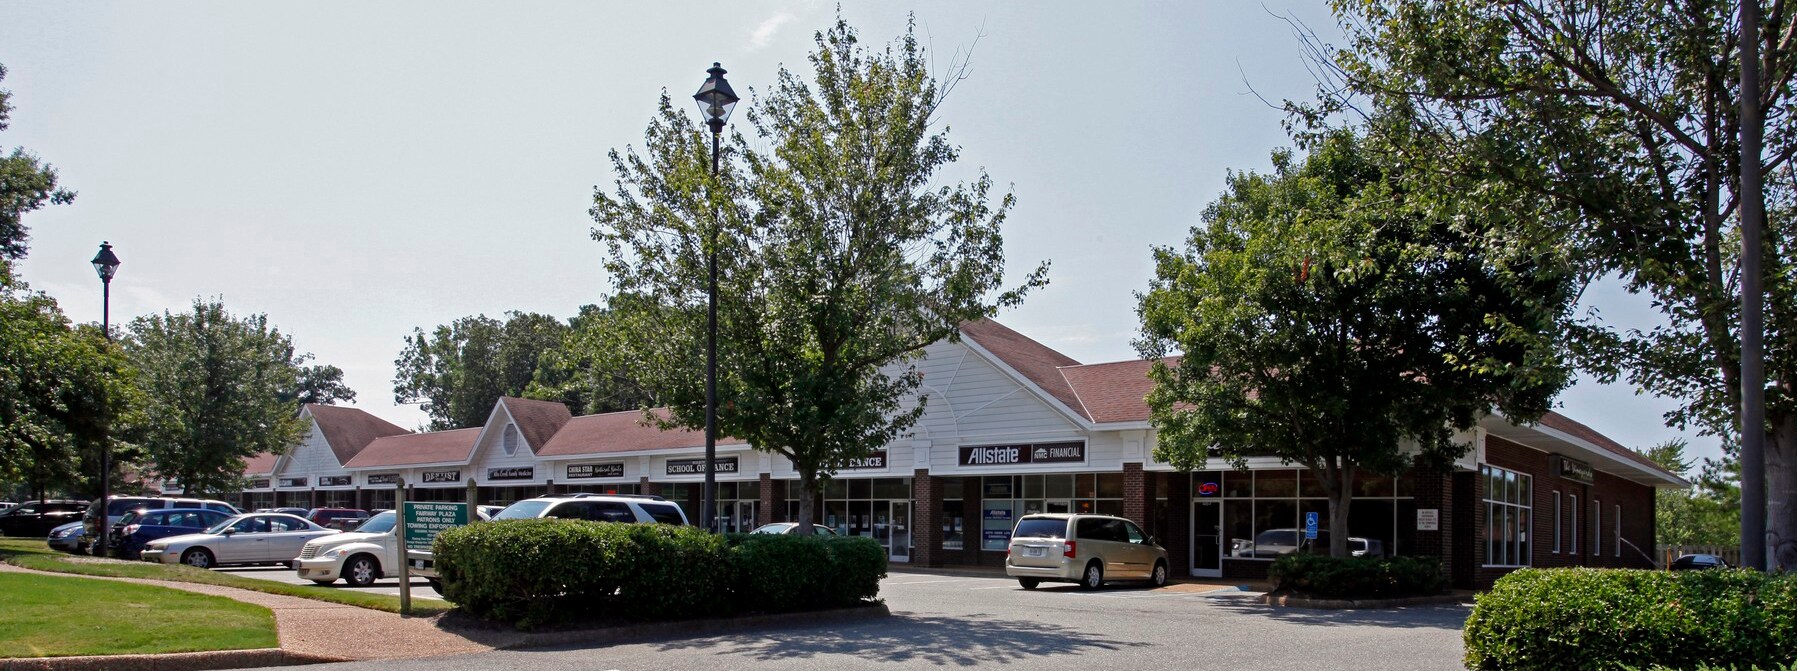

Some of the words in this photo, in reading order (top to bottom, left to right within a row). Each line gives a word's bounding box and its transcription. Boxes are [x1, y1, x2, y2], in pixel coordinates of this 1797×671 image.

[968, 447, 1019, 464] Allstate
[1049, 447, 1081, 458] FINANCIAL
[582, 465, 593, 473] STAR
[668, 465, 695, 473] SCHOOL
[714, 463, 734, 471] ANCE
[425, 472, 457, 481] DENTIST
